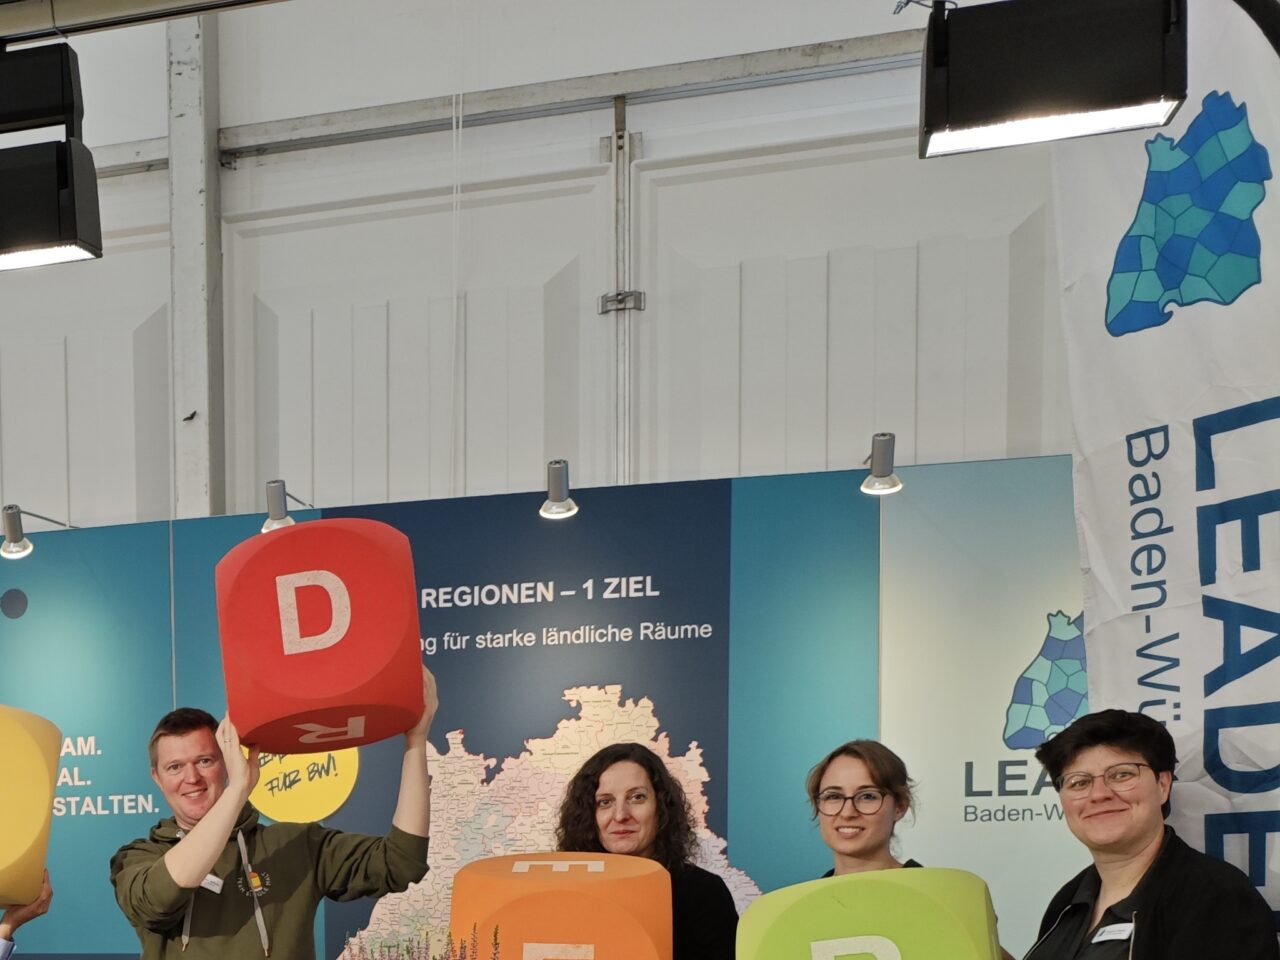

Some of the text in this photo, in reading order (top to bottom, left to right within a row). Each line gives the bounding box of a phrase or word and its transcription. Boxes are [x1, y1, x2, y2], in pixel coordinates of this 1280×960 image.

[1125, 424, 1181, 729] Baden-Wü
[421, 581, 554, 609] REGIONEN
[582, 579, 594, 599] 1
[603, 576, 660, 599] ZIEL
[276, 569, 351, 655] D
[443, 632, 470, 651] für
[475, 628, 536, 648] starke
[542, 623, 633, 646] ländliche
[640, 621, 713, 640] Räume
[1193, 396, 1280, 933] LEADE
[293, 715, 365, 744] R
[60, 736, 102, 756] AM.
[57, 767, 91, 786] AL.
[52, 794, 160, 816] STALTEN.
[964, 804, 1064, 823] Baden-W
